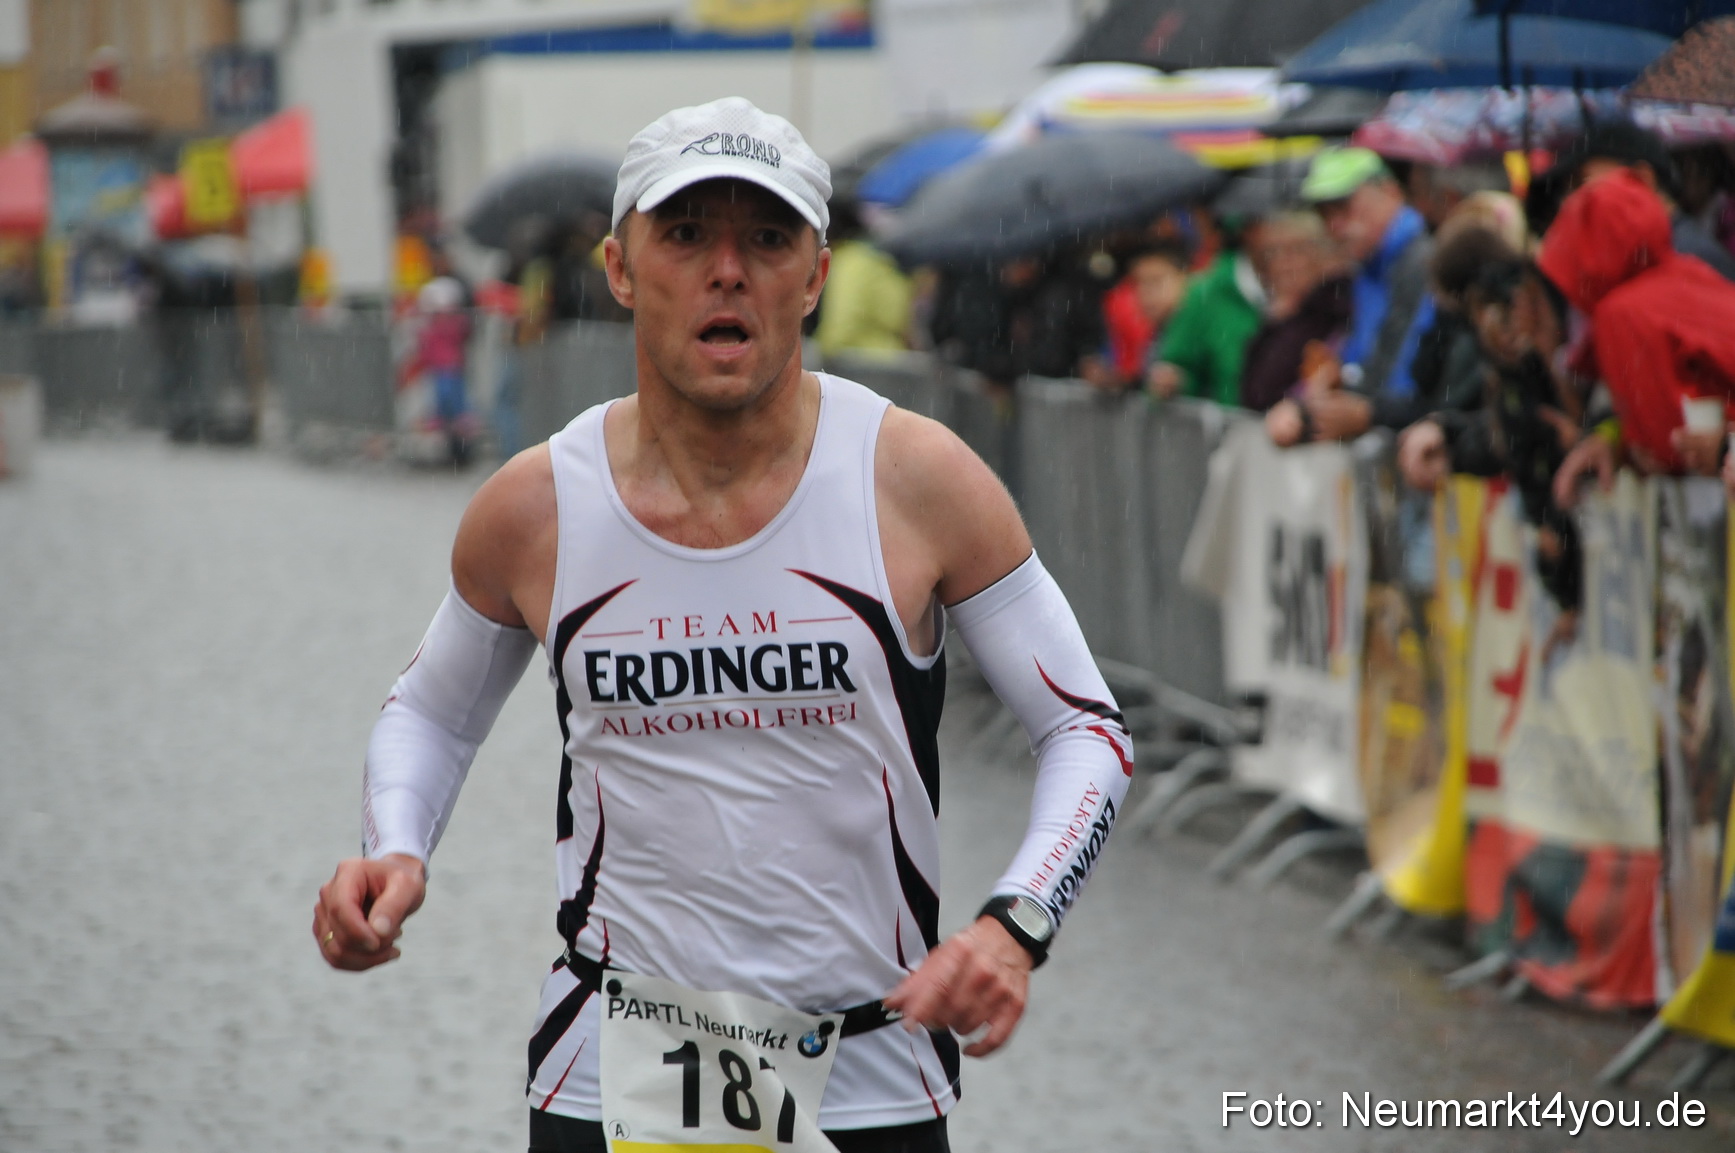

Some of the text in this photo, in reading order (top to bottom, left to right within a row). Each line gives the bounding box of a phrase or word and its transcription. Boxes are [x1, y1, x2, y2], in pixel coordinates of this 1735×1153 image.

[721, 149, 780, 168] INNOVATIONS
[649, 611, 778, 640] TEAM
[583, 641, 858, 706] ERDINGER
[600, 702, 857, 737] ALKOHOLFREI
[608, 998, 691, 1027] PARTL
[614, 1123, 626, 1138] A
